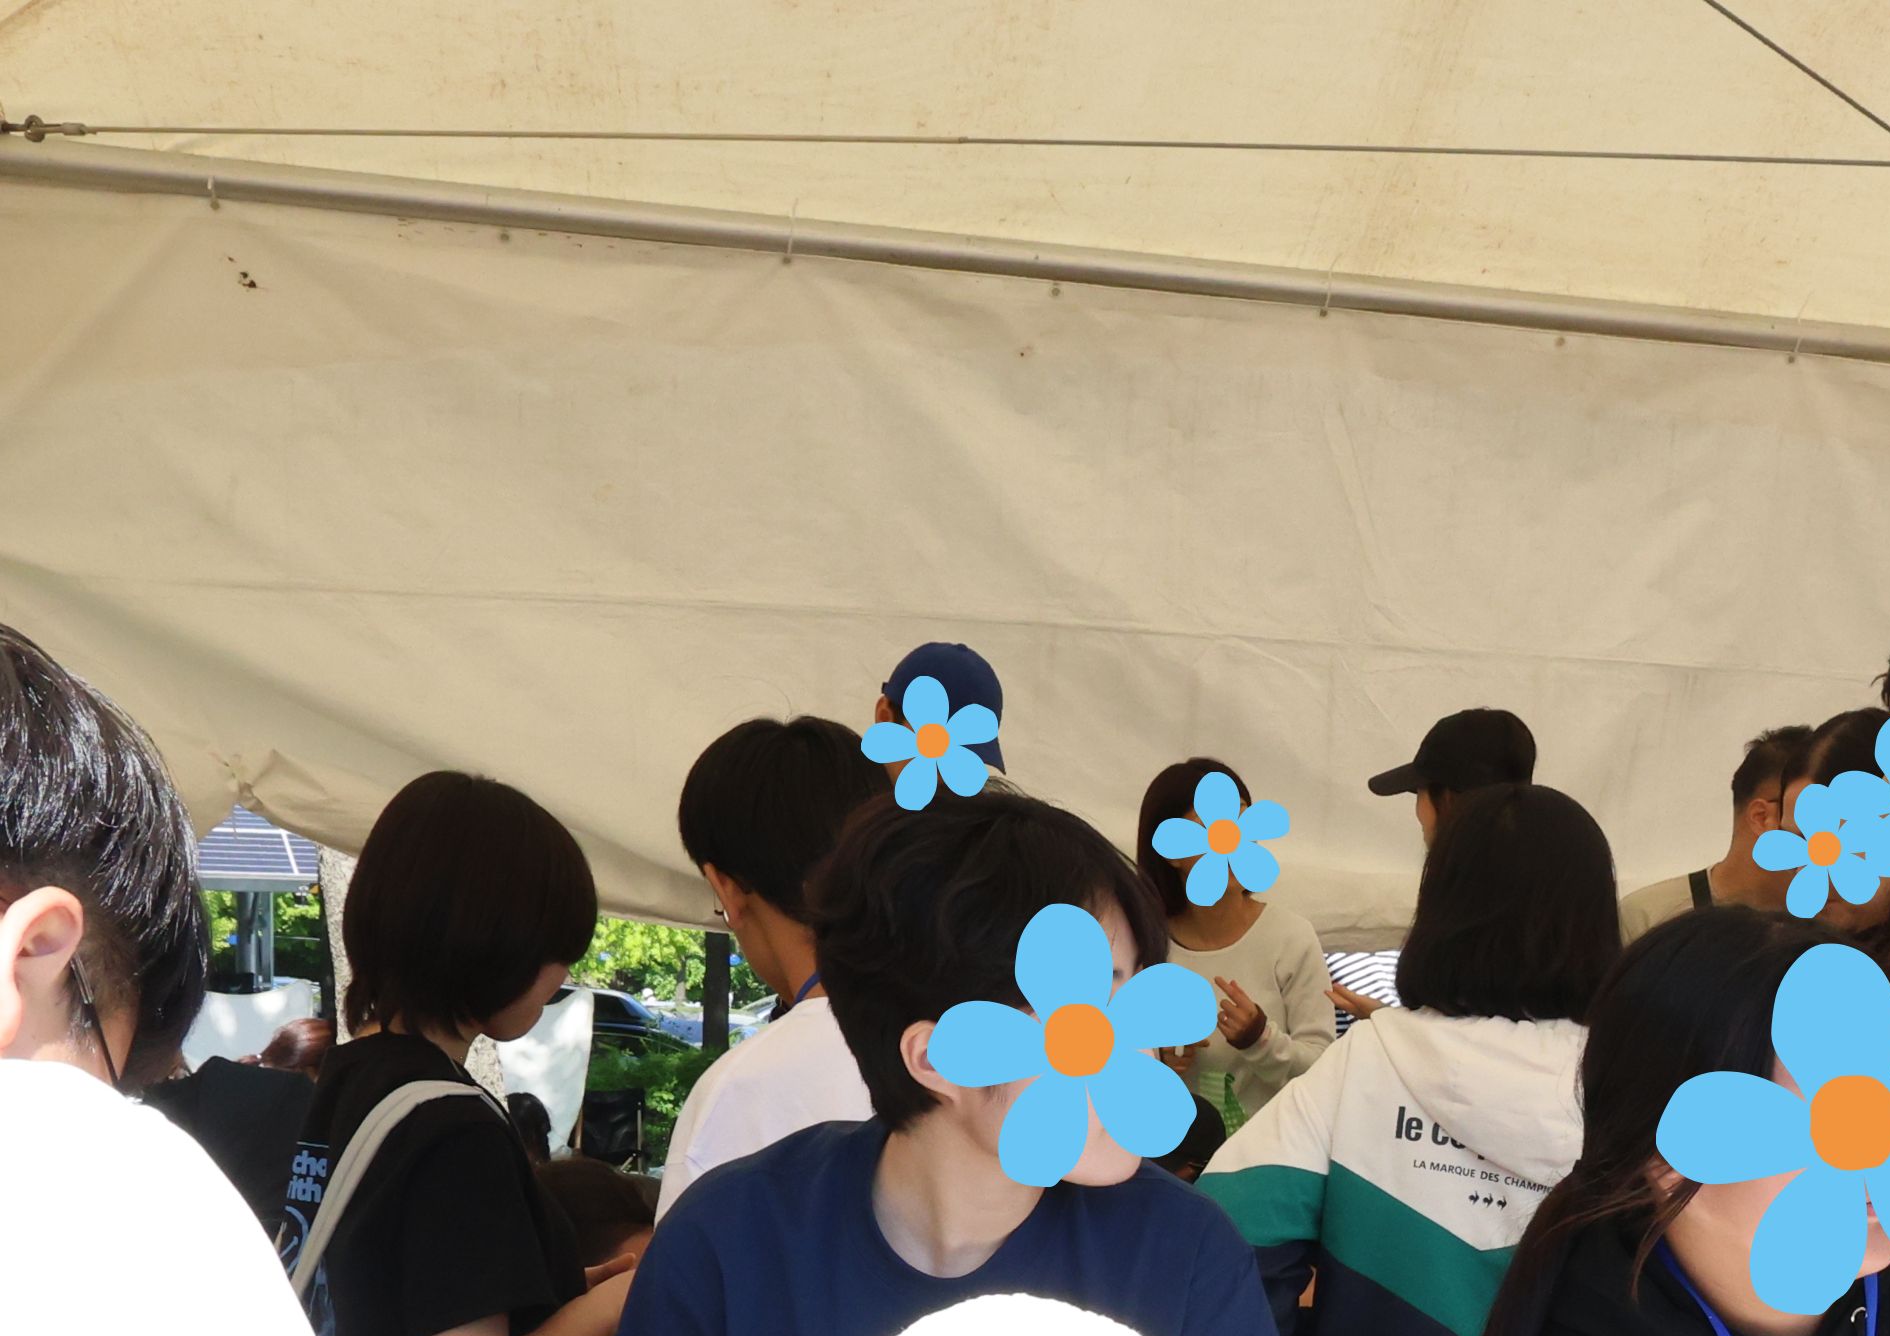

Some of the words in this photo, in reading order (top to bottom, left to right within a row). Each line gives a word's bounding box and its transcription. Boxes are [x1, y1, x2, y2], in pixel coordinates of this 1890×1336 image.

[1395, 1106, 1423, 1141] le
[1413, 1159, 1427, 1170] LA
[1429, 1162, 1476, 1178] MARQUE
[1480, 1171, 1499, 1183] DES
